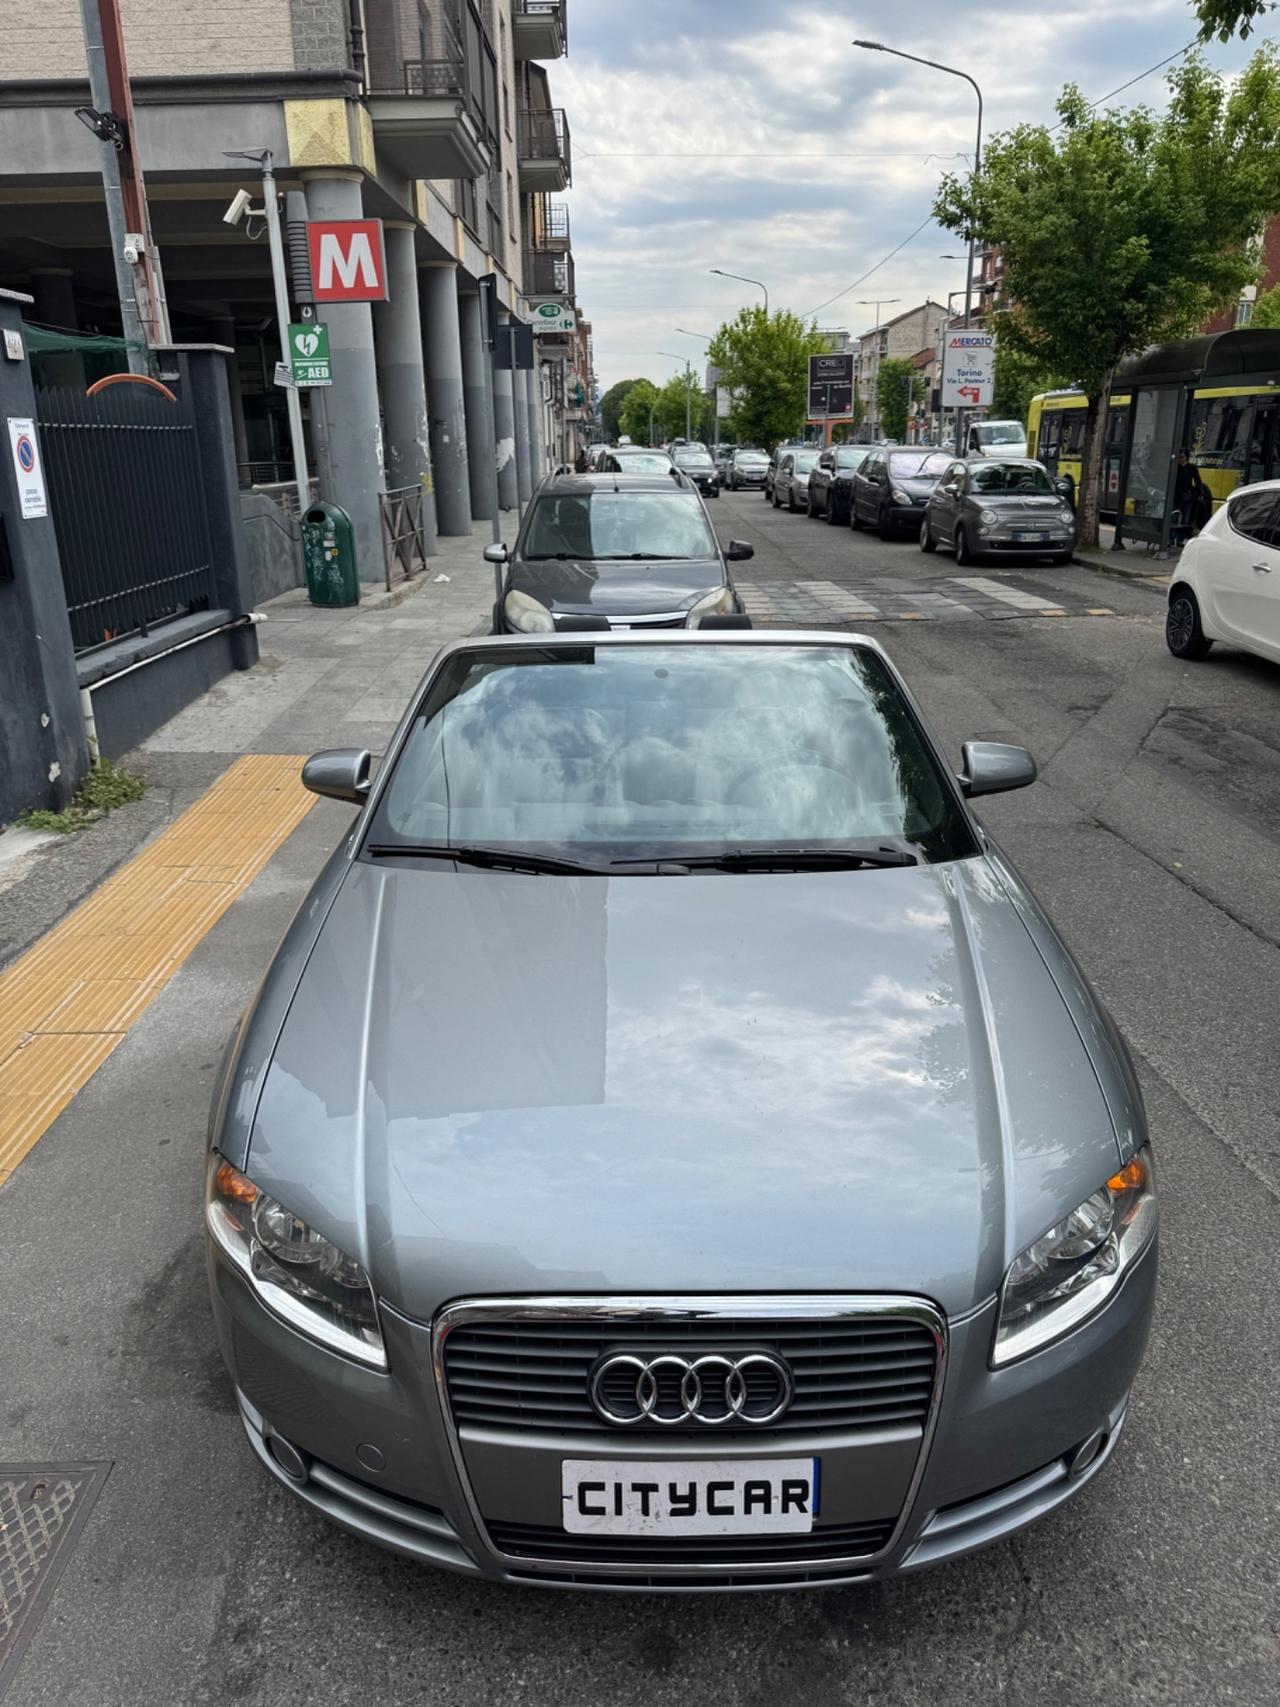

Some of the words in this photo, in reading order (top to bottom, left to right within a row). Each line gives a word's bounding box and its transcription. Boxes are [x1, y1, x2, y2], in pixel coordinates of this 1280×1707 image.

[319, 232, 379, 289] M
[949, 338, 992, 347] MERCATO
[308, 367, 329, 378] AED
[957, 368, 983, 377] Torino
[577, 1479, 809, 1517] CITYCAR
